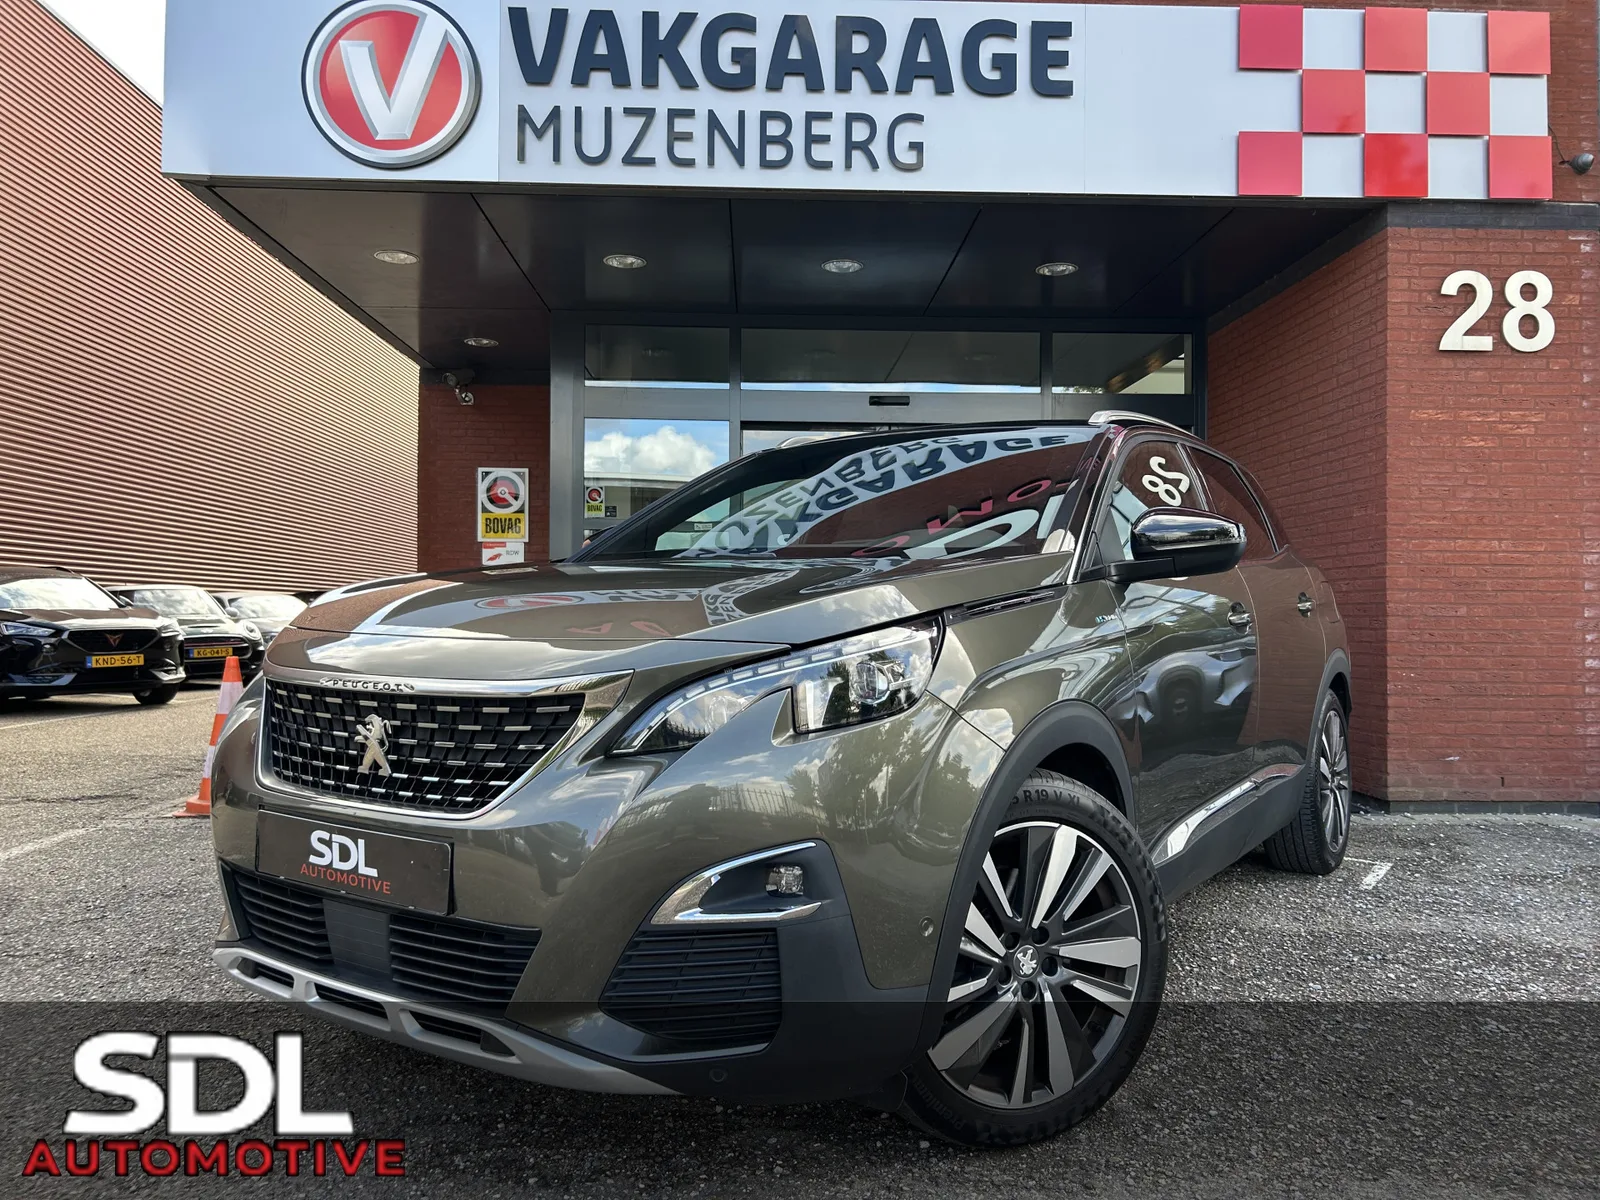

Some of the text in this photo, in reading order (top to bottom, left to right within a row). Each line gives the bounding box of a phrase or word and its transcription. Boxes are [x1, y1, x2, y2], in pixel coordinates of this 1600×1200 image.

[507, 6, 1074, 98] VAKGARAGE
[516, 104, 925, 172] MUZENBERG
[1438, 269, 1556, 353] 28
[587, 504, 603, 513] BOVAG
[485, 517, 521, 534] BOVAG
[95, 654, 143, 666] KND-56-T
[196, 648, 230, 657] KG-041-S
[332, 679, 403, 692] PEUGEOT
[308, 829, 379, 878] SDL
[300, 862, 391, 895] AUTOMOTIVE
